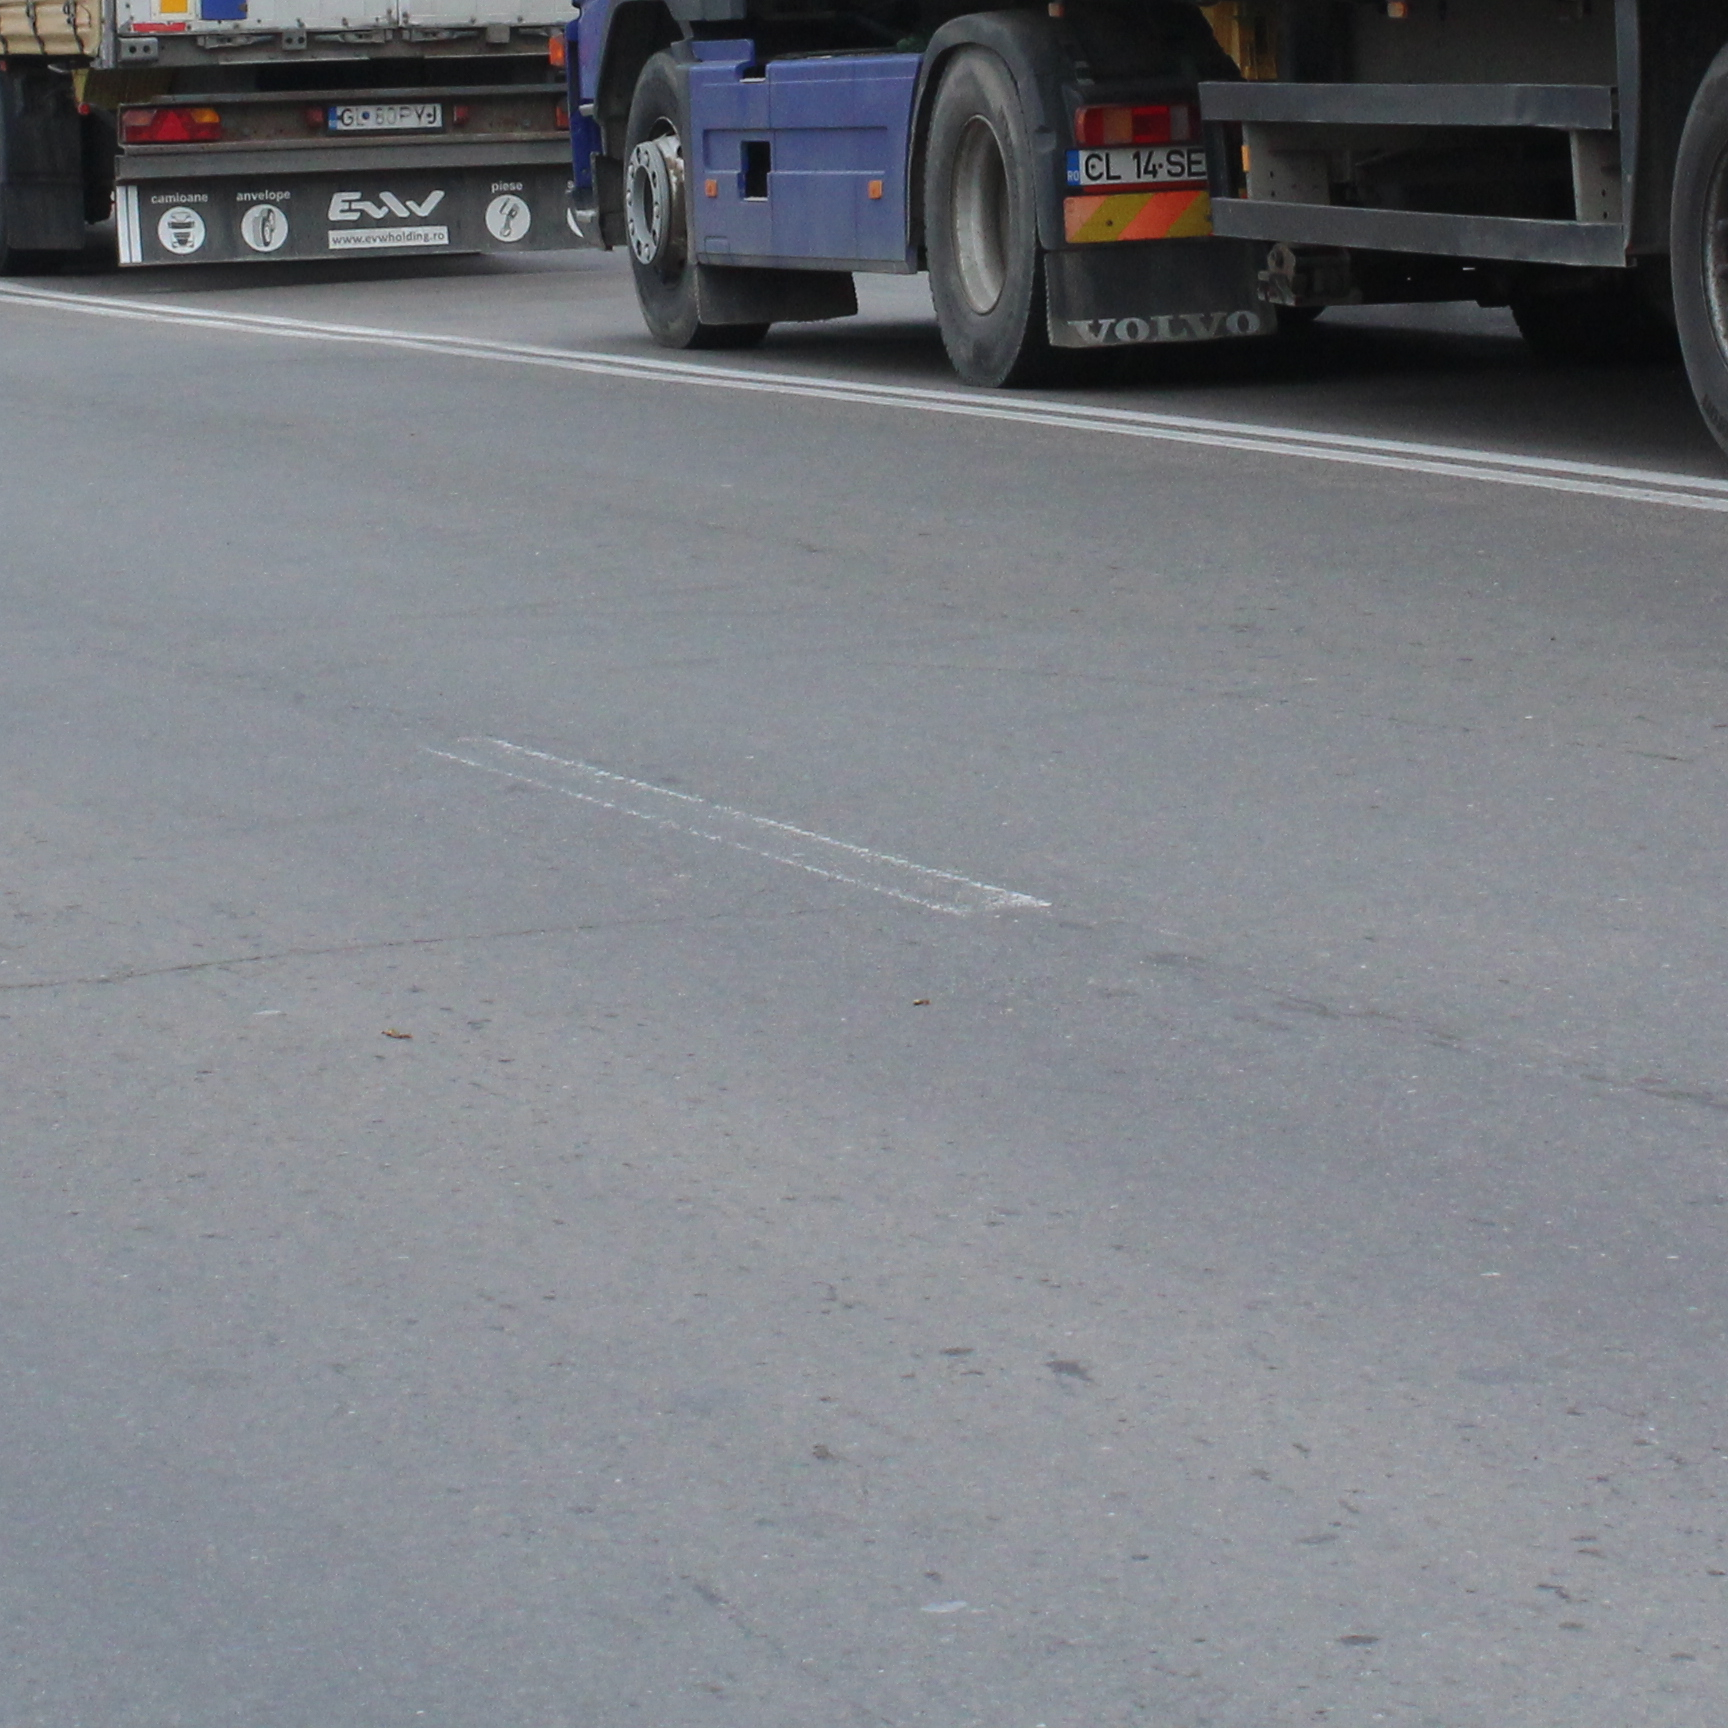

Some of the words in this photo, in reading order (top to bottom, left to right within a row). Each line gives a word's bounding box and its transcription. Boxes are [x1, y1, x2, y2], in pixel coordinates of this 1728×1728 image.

[1085, 153, 1121, 181] CL
[1132, 150, 1158, 179] 14
[1166, 148, 1207, 178] SE
[491, 182, 523, 193] piese
[151, 192, 209, 204] camioane
[236, 190, 291, 202] anvelope
[331, 230, 446, 247] www.evwholding.ro
[1067, 310, 1260, 342] VOLVO
